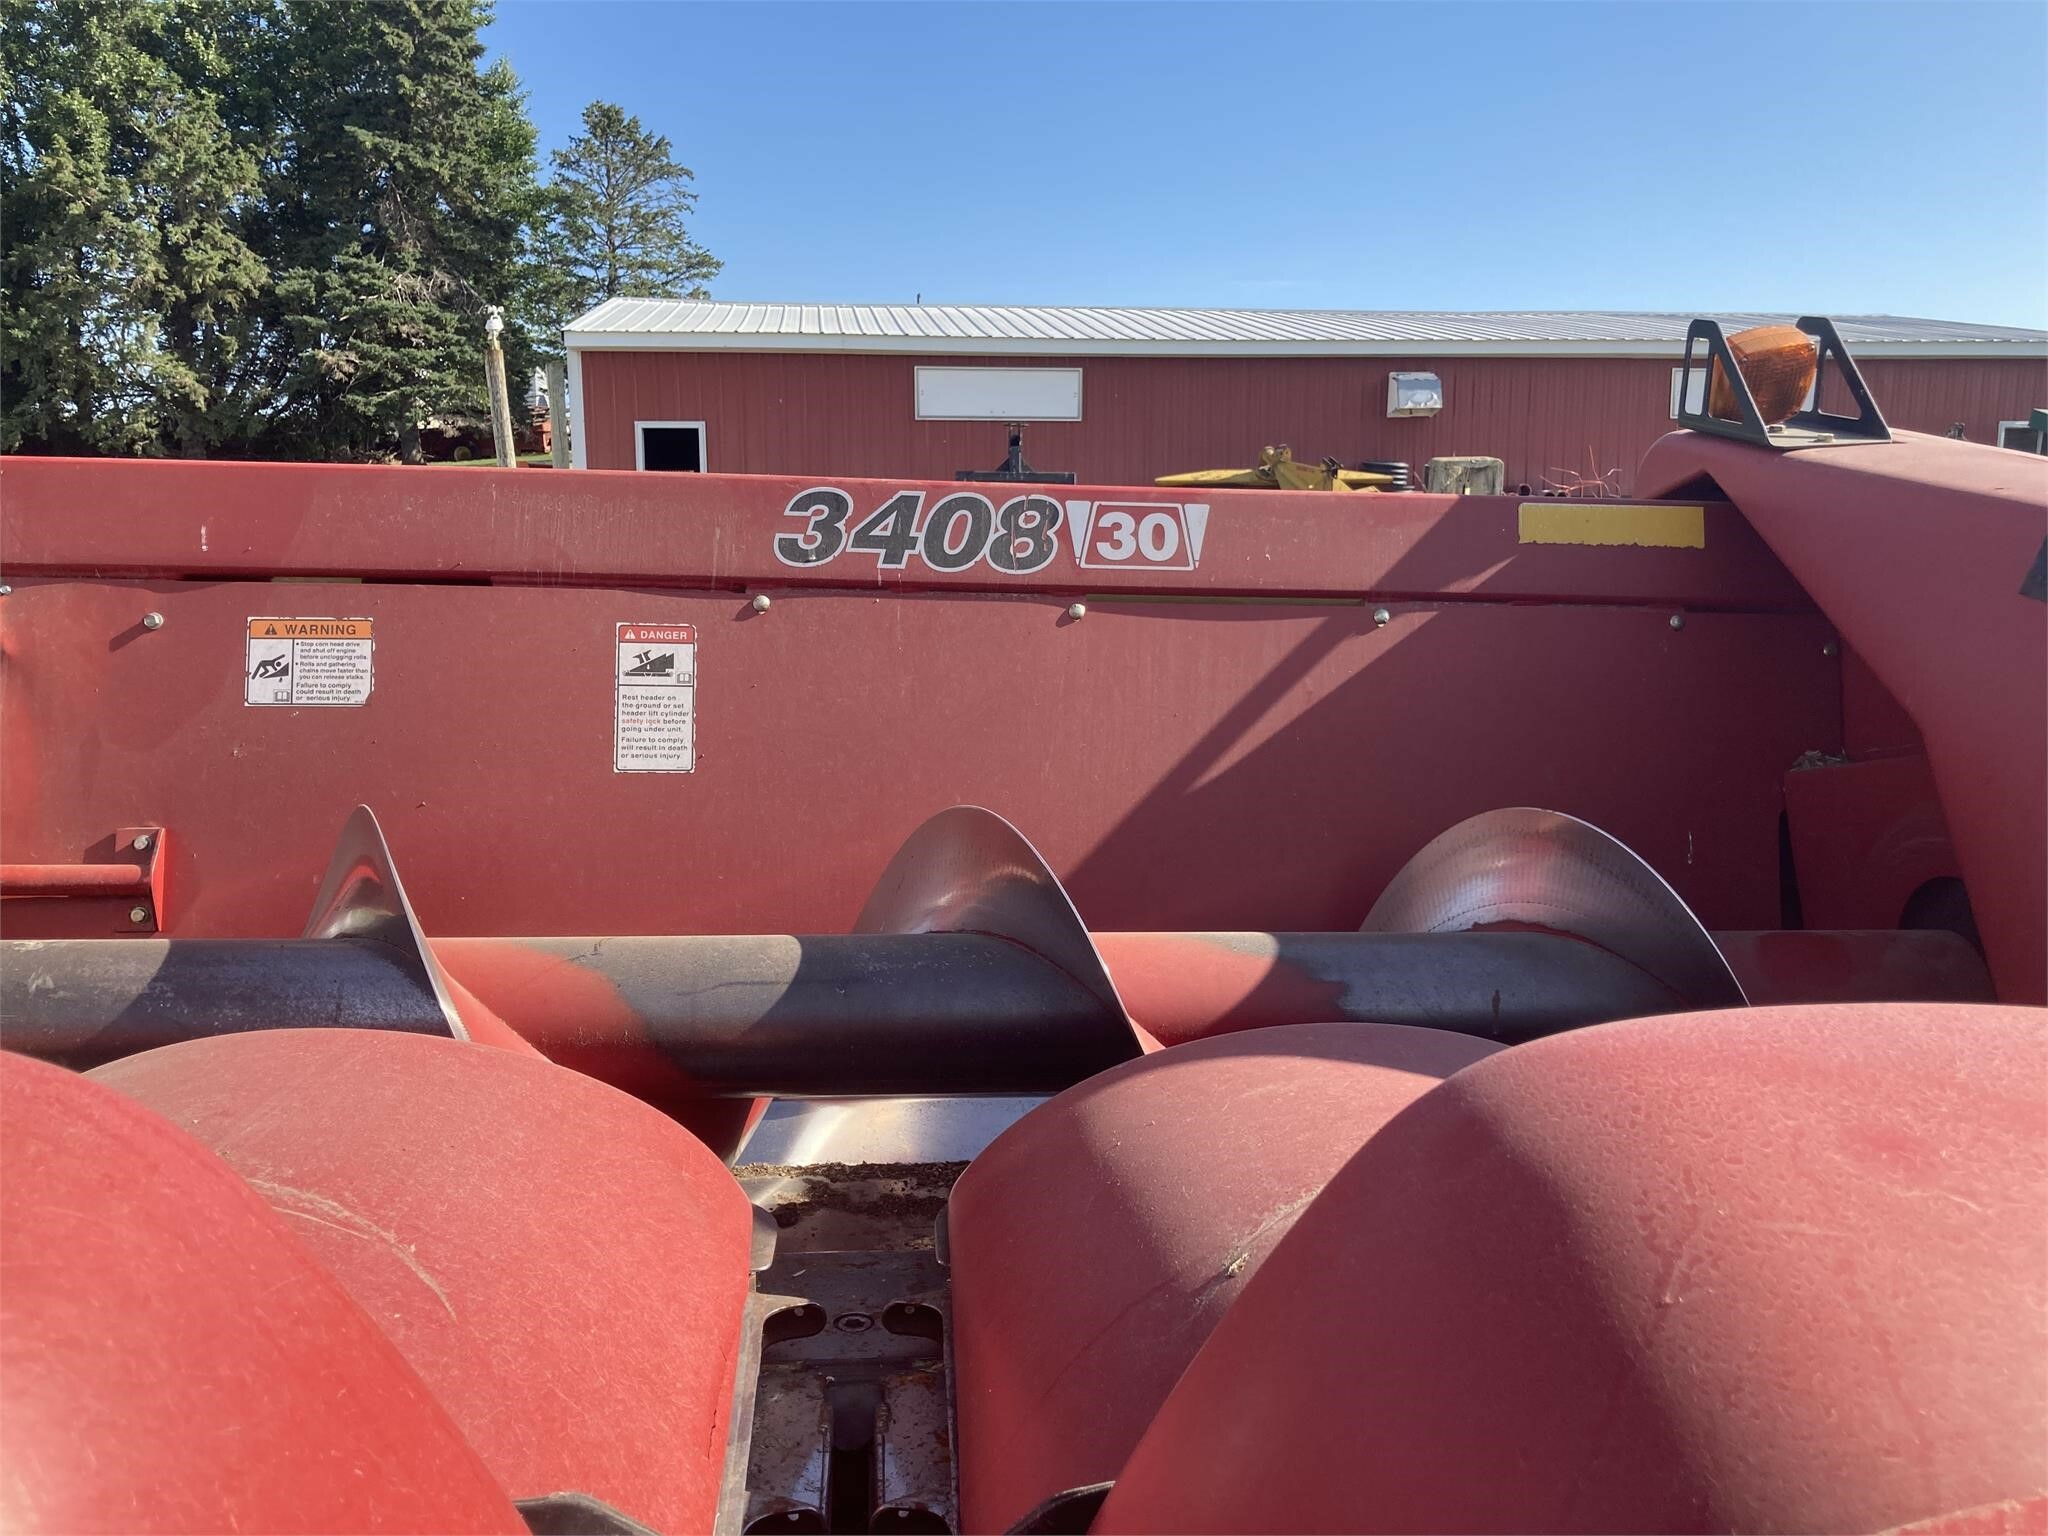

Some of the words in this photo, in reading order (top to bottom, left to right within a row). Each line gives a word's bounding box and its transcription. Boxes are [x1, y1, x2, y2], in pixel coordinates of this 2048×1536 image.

[774, 487, 1063, 574] 3408
[1096, 512, 1180, 562] 30
[285, 624, 356, 634] WARNING
[640, 631, 687, 639] DANGER
